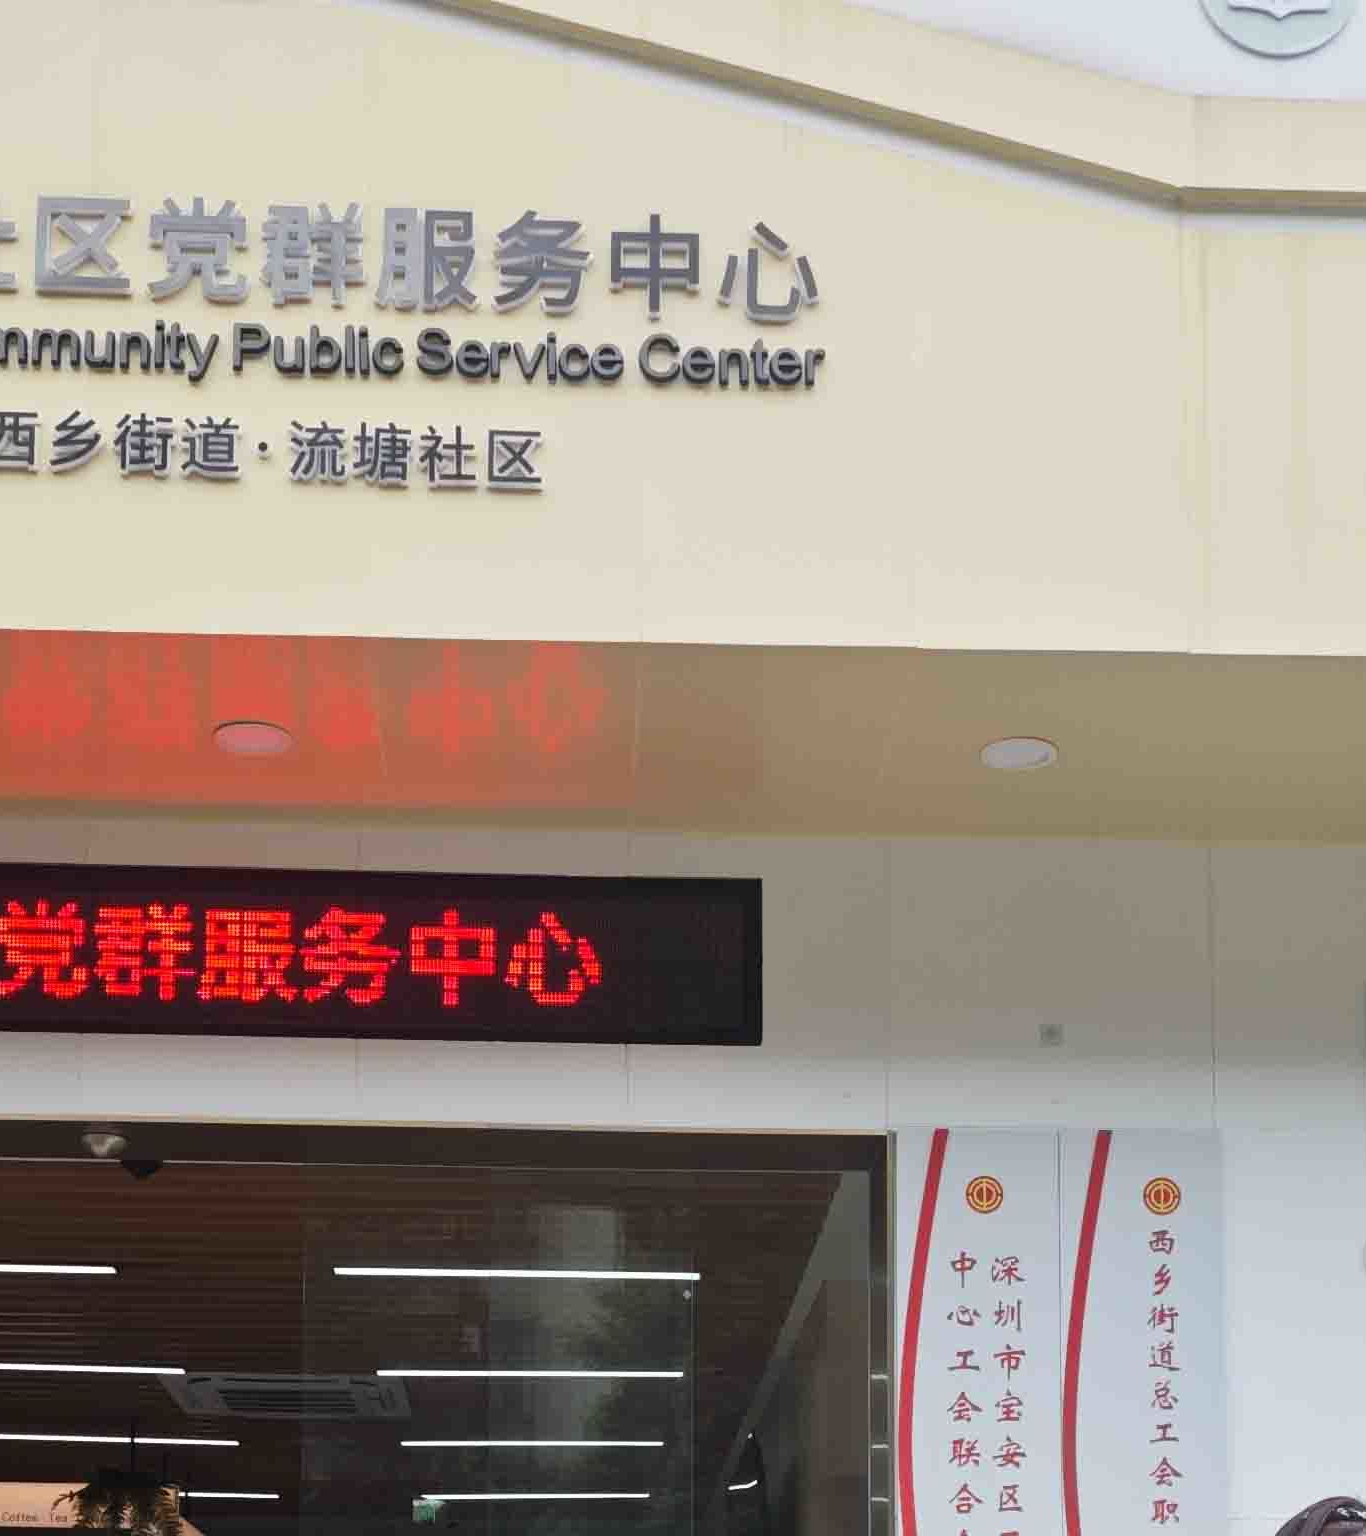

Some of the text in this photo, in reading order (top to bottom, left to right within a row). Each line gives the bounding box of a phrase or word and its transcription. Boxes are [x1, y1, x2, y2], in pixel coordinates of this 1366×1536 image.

[232, 321, 405, 378] Public
[416, 327, 624, 386] Service
[638, 332, 826, 390] Center
